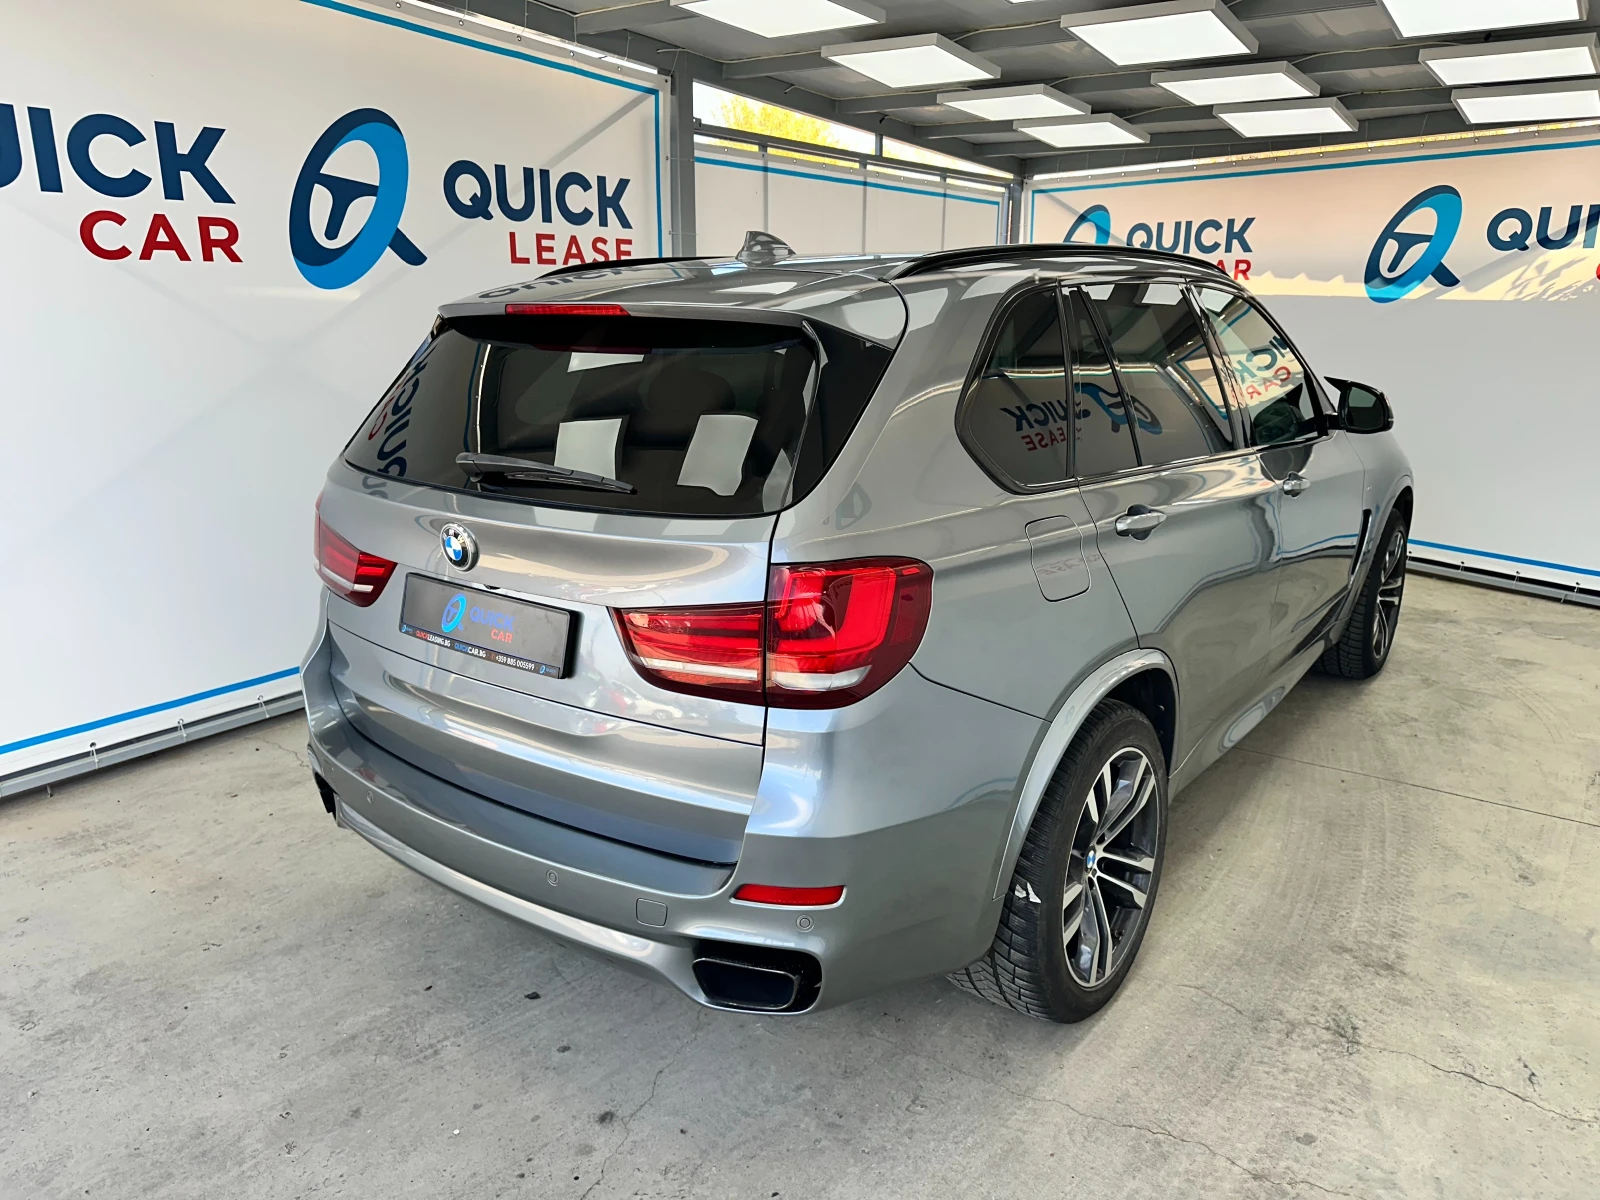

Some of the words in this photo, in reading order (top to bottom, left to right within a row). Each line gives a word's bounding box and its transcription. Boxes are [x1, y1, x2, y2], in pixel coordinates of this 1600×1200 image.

[0, 103, 236, 204] ICK
[443, 159, 633, 229] QUICK
[79, 210, 243, 263] CAR
[1126, 217, 1256, 254] QUICK
[470, 606, 515, 632] QUICK
[491, 628, 513, 643] CAR
